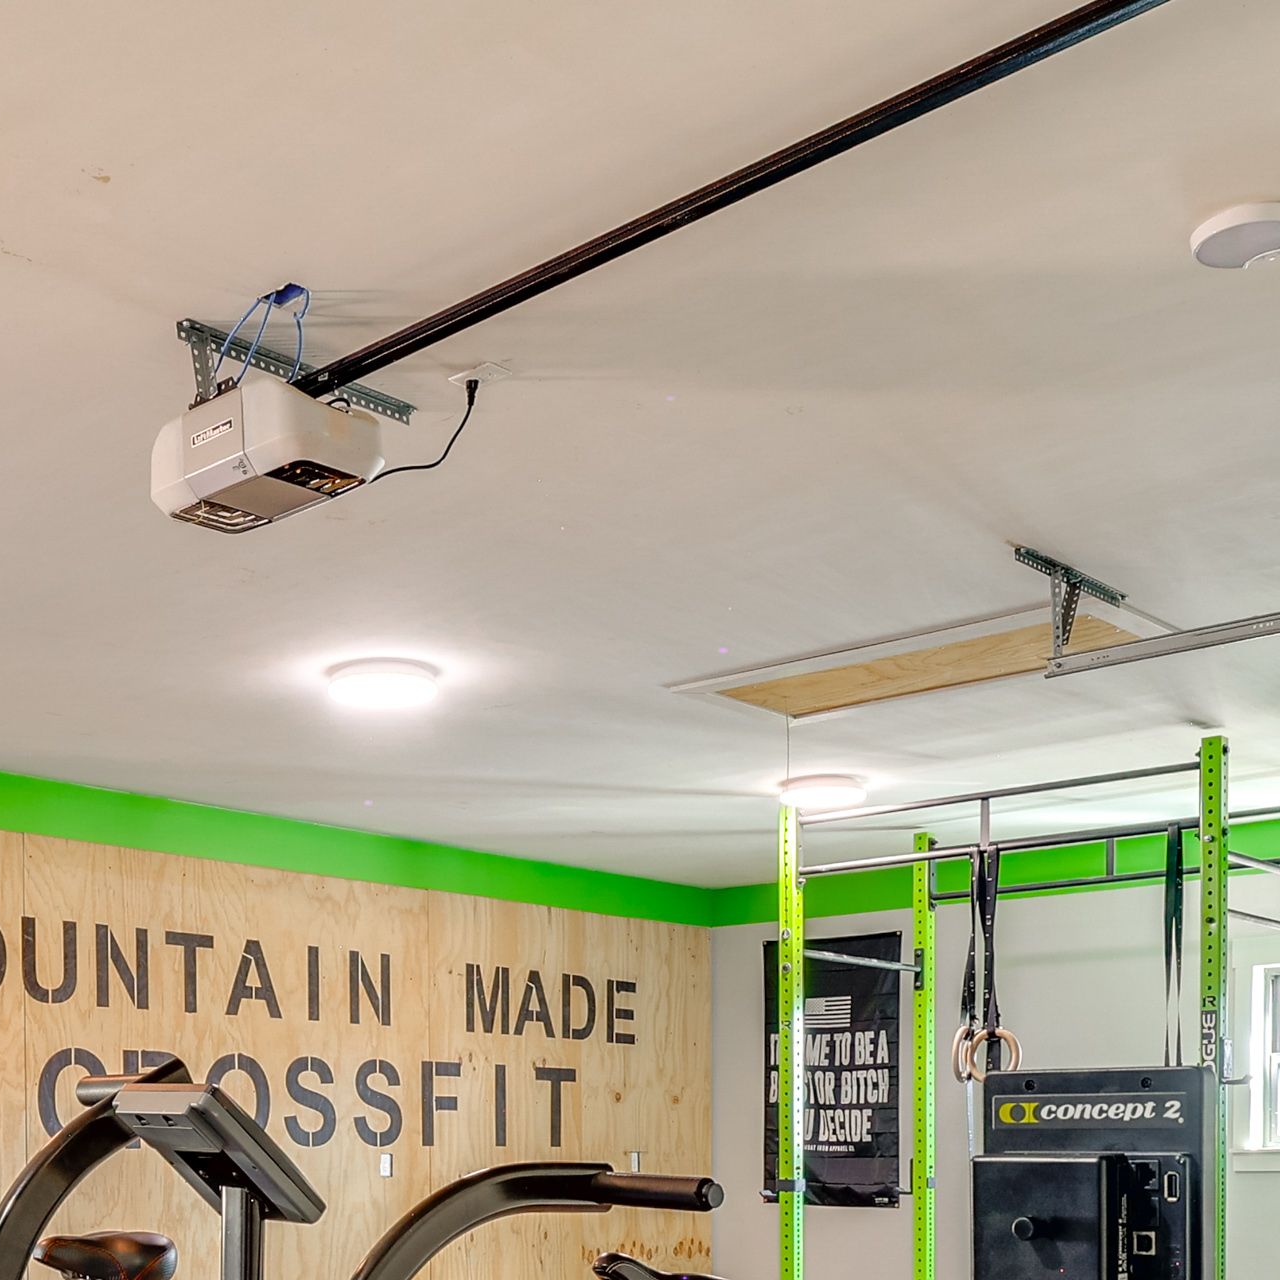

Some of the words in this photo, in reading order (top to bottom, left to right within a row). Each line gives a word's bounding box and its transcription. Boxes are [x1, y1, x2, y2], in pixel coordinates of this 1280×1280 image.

[465, 962, 637, 1045] MADE
[833, 1031, 852, 1066] TO
[854, 1031, 875, 1065] BE
[876, 1029, 889, 1064] A
[814, 1070, 836, 1105] OR
[840, 1068, 890, 1105] BITCH
[819, 1108, 872, 1142] DECIDE
[1039, 1101, 1156, 1122] concept
[1163, 1100, 1181, 1120] 2
